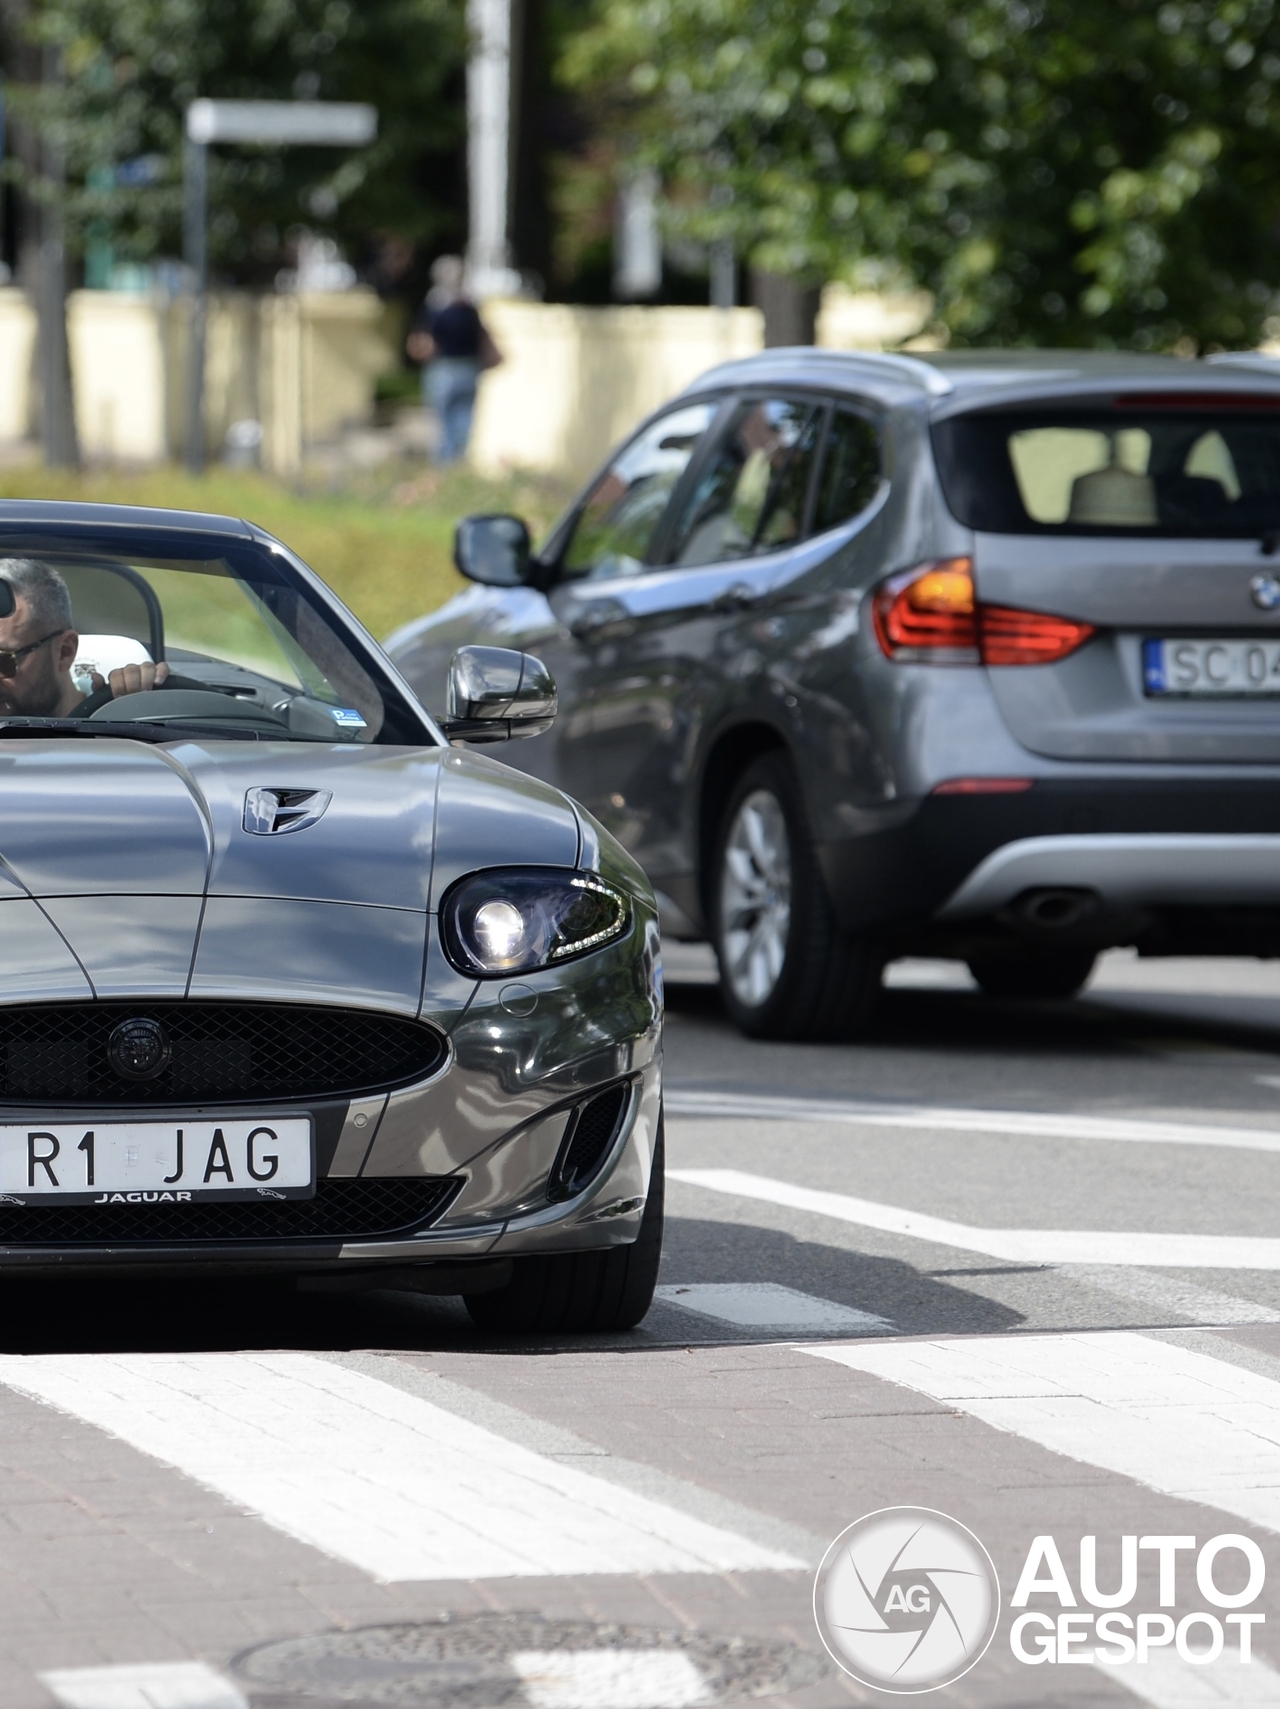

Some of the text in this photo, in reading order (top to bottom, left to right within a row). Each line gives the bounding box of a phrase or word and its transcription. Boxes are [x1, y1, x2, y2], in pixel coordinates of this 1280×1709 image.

[1174, 644, 1229, 686] SC
[26, 1126, 279, 1187] R1 JAG
[94, 1191, 192, 1204] JAGUAR
